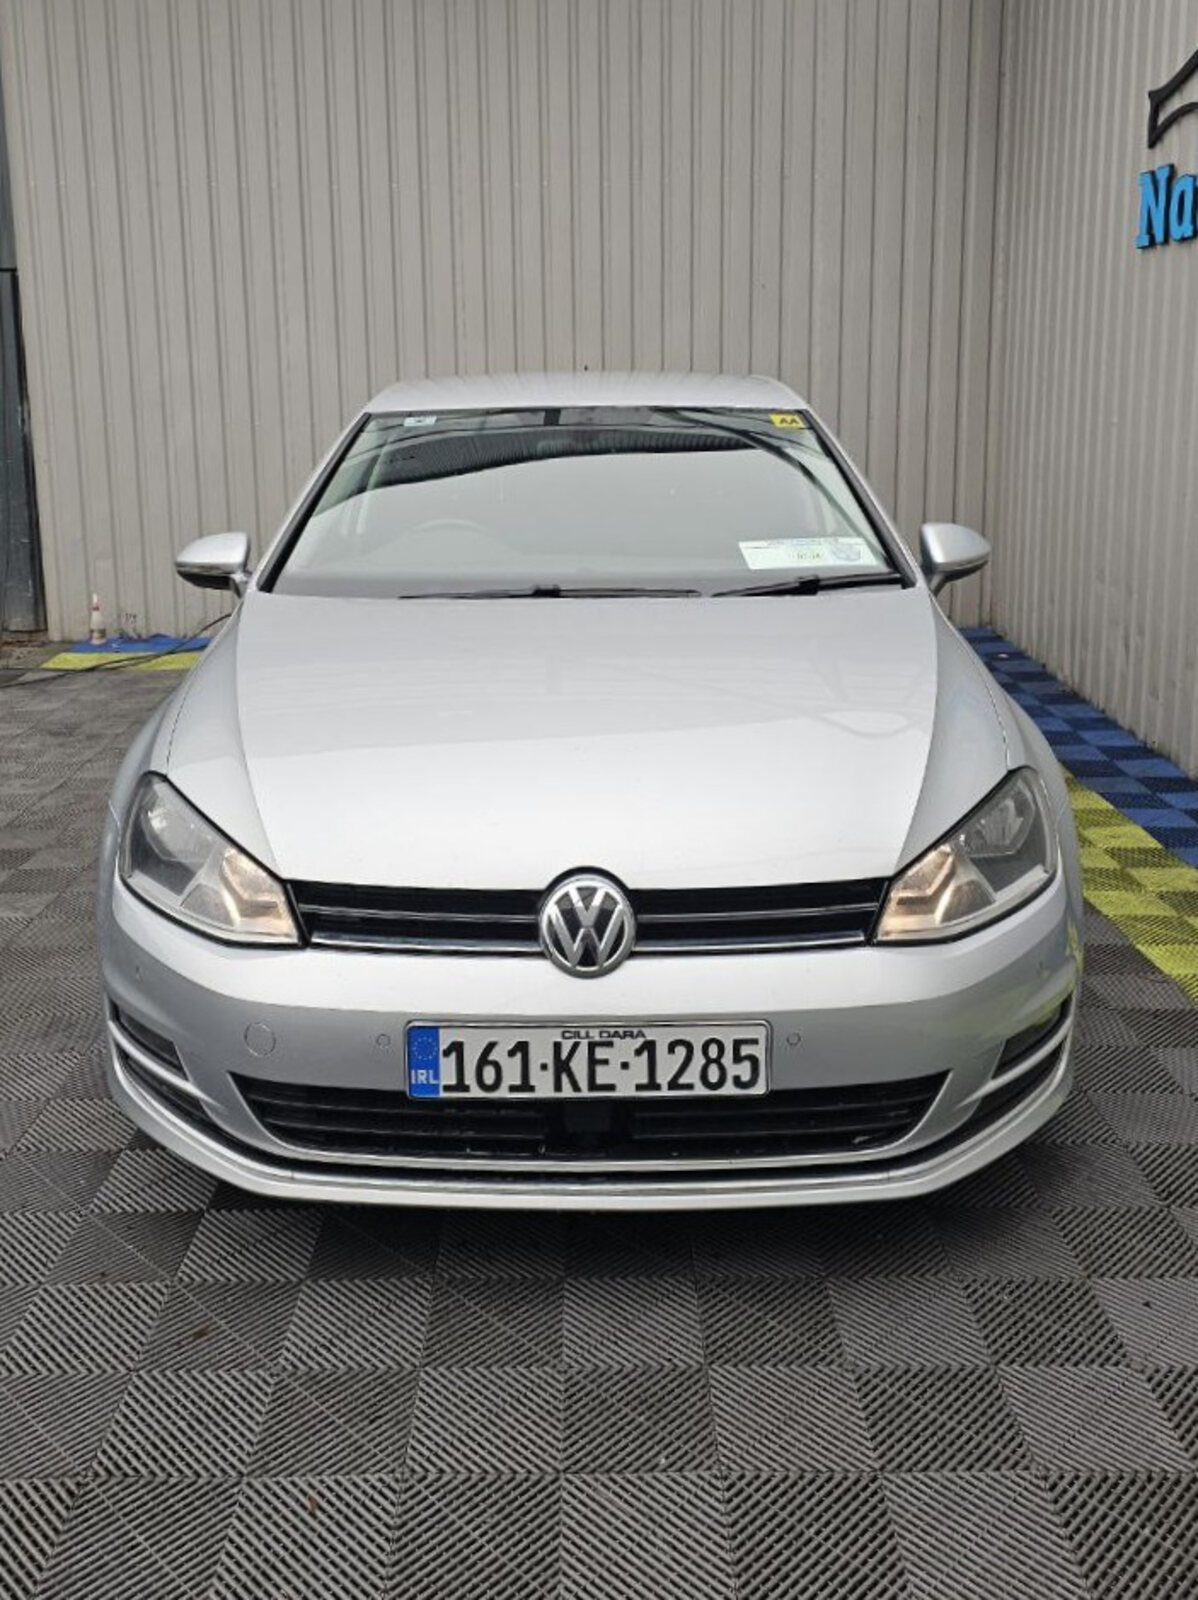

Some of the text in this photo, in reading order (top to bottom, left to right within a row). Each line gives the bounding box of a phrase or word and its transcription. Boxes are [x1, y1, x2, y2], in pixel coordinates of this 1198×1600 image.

[1136, 163, 1198, 250] Na
[561, 1029, 646, 1040] CILL DARA
[411, 1069, 438, 1085] IRL
